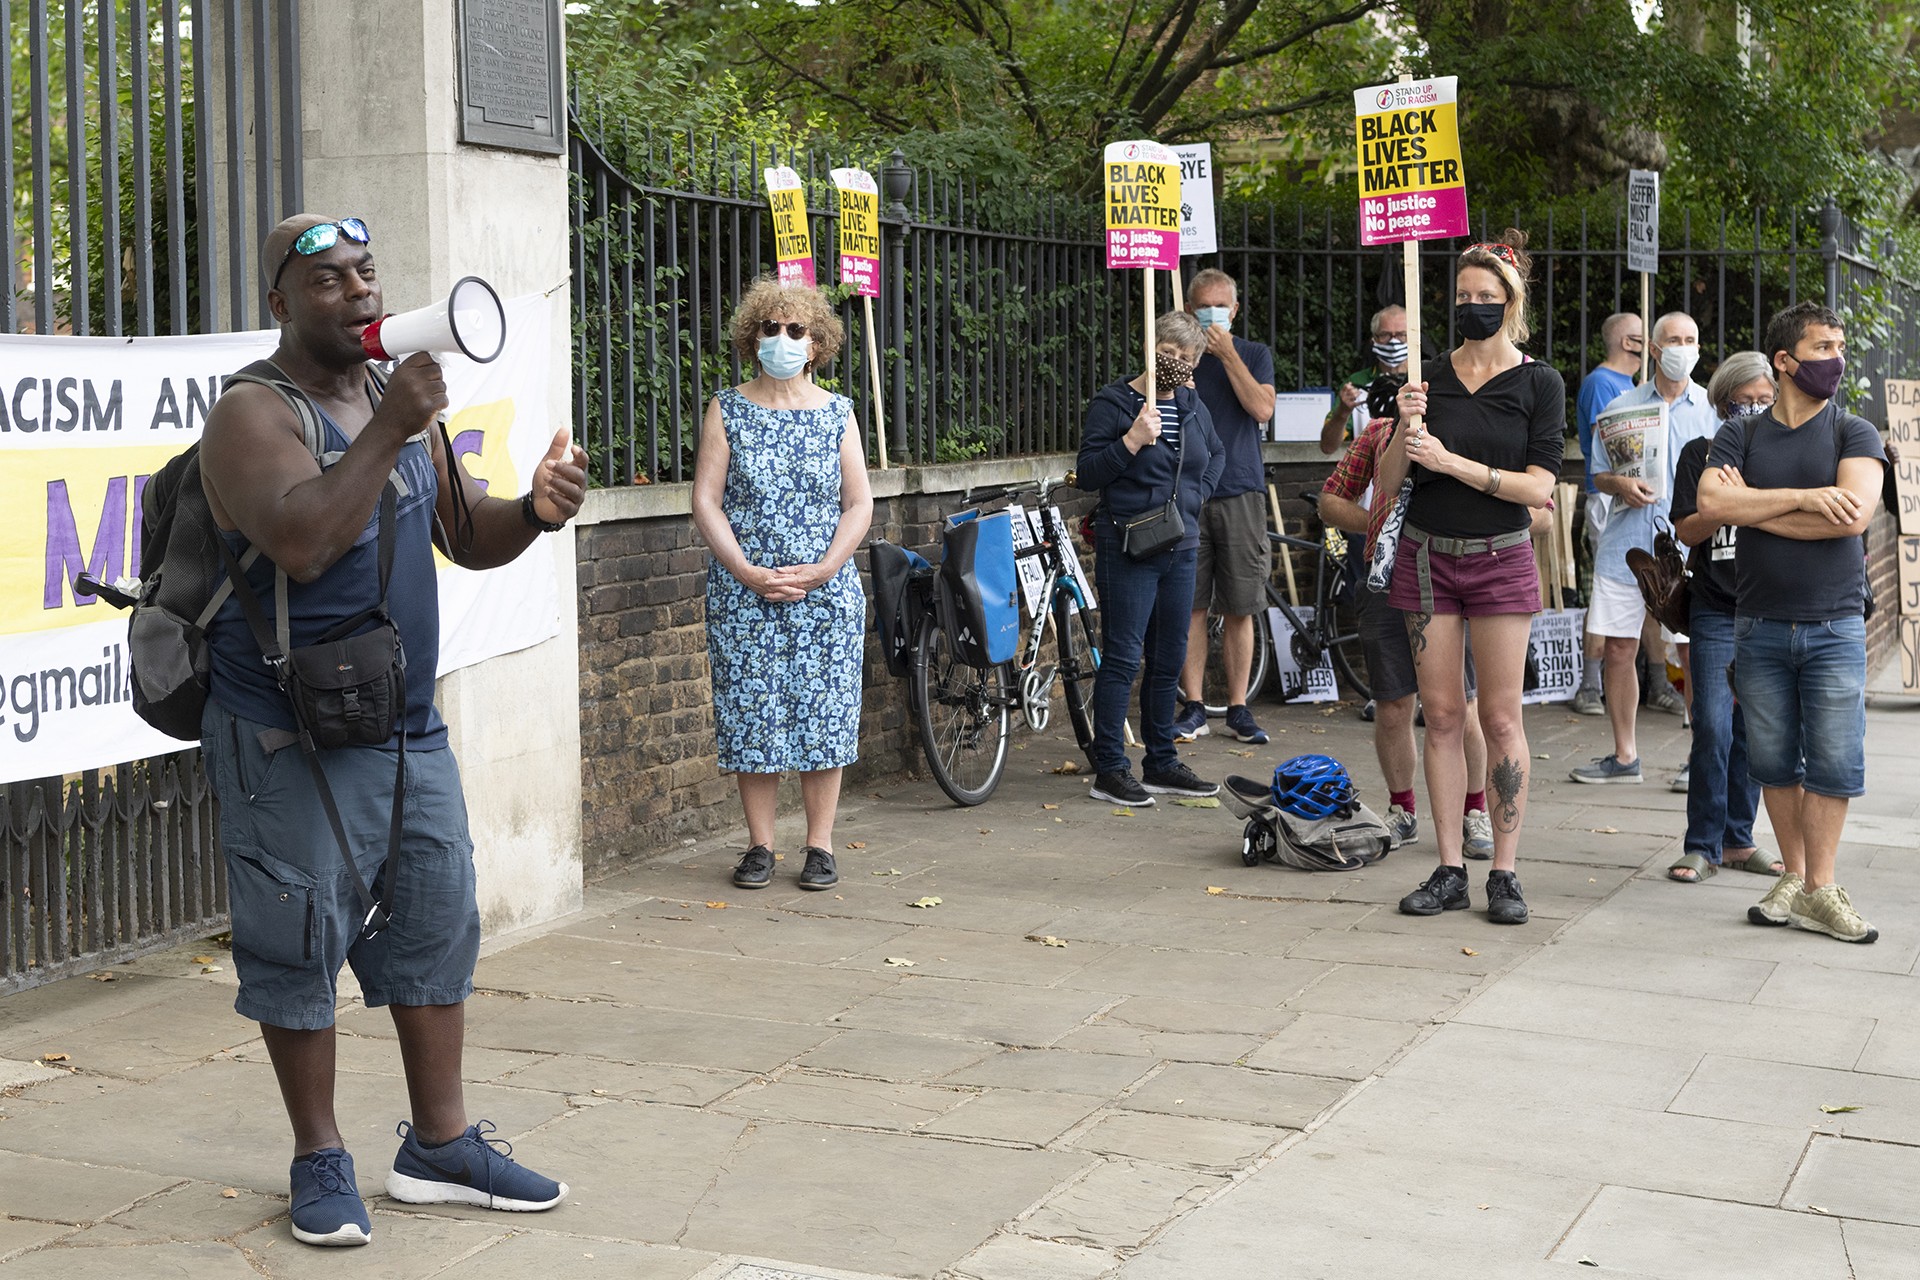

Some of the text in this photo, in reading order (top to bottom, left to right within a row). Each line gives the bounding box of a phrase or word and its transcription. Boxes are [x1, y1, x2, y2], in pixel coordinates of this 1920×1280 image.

[1396, 85, 1433, 97] STAND UP
[1396, 93, 1438, 106] TO RACISM
[1362, 109, 1437, 141] BLACK
[1363, 137, 1427, 167] LIVES
[1110, 165, 1165, 185] BLACK
[1364, 159, 1459, 192] MATTER
[1111, 185, 1159, 204] LIVES
[1365, 194, 1436, 216] No justice
[1111, 206, 1178, 227] MATTER
[1366, 214, 1430, 233] No peace
[1111, 231, 1128, 243] No
[1111, 245, 1128, 257] No
[843, 256, 853, 270] No
[1631, 418, 1659, 429] Worker
[1540, 639, 1572, 655] FALL
[1284, 671, 1333, 689] GEFFYE
[0, 642, 131, 743] gmail.
